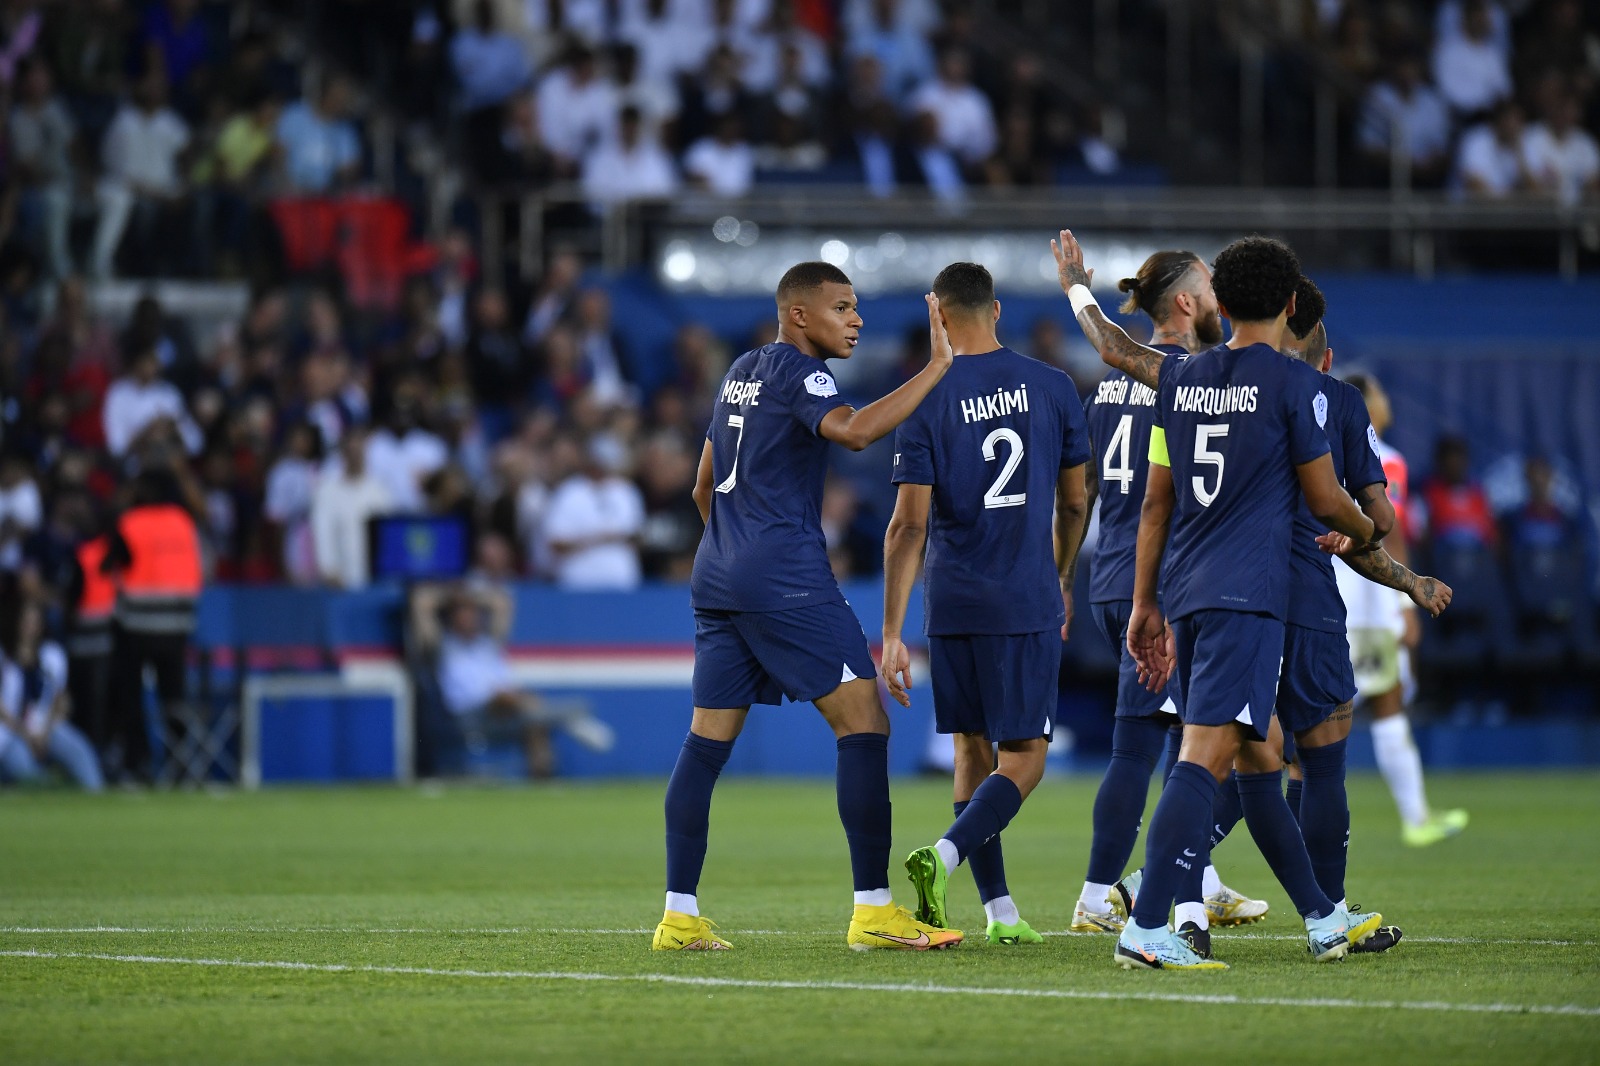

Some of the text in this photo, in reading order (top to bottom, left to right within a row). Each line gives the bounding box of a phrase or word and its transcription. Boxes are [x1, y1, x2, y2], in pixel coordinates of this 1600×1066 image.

[715, 414, 744, 494] 7
[981, 427, 1025, 509] 2
[1103, 414, 1134, 495] 4
[1191, 423, 1230, 508] 5
